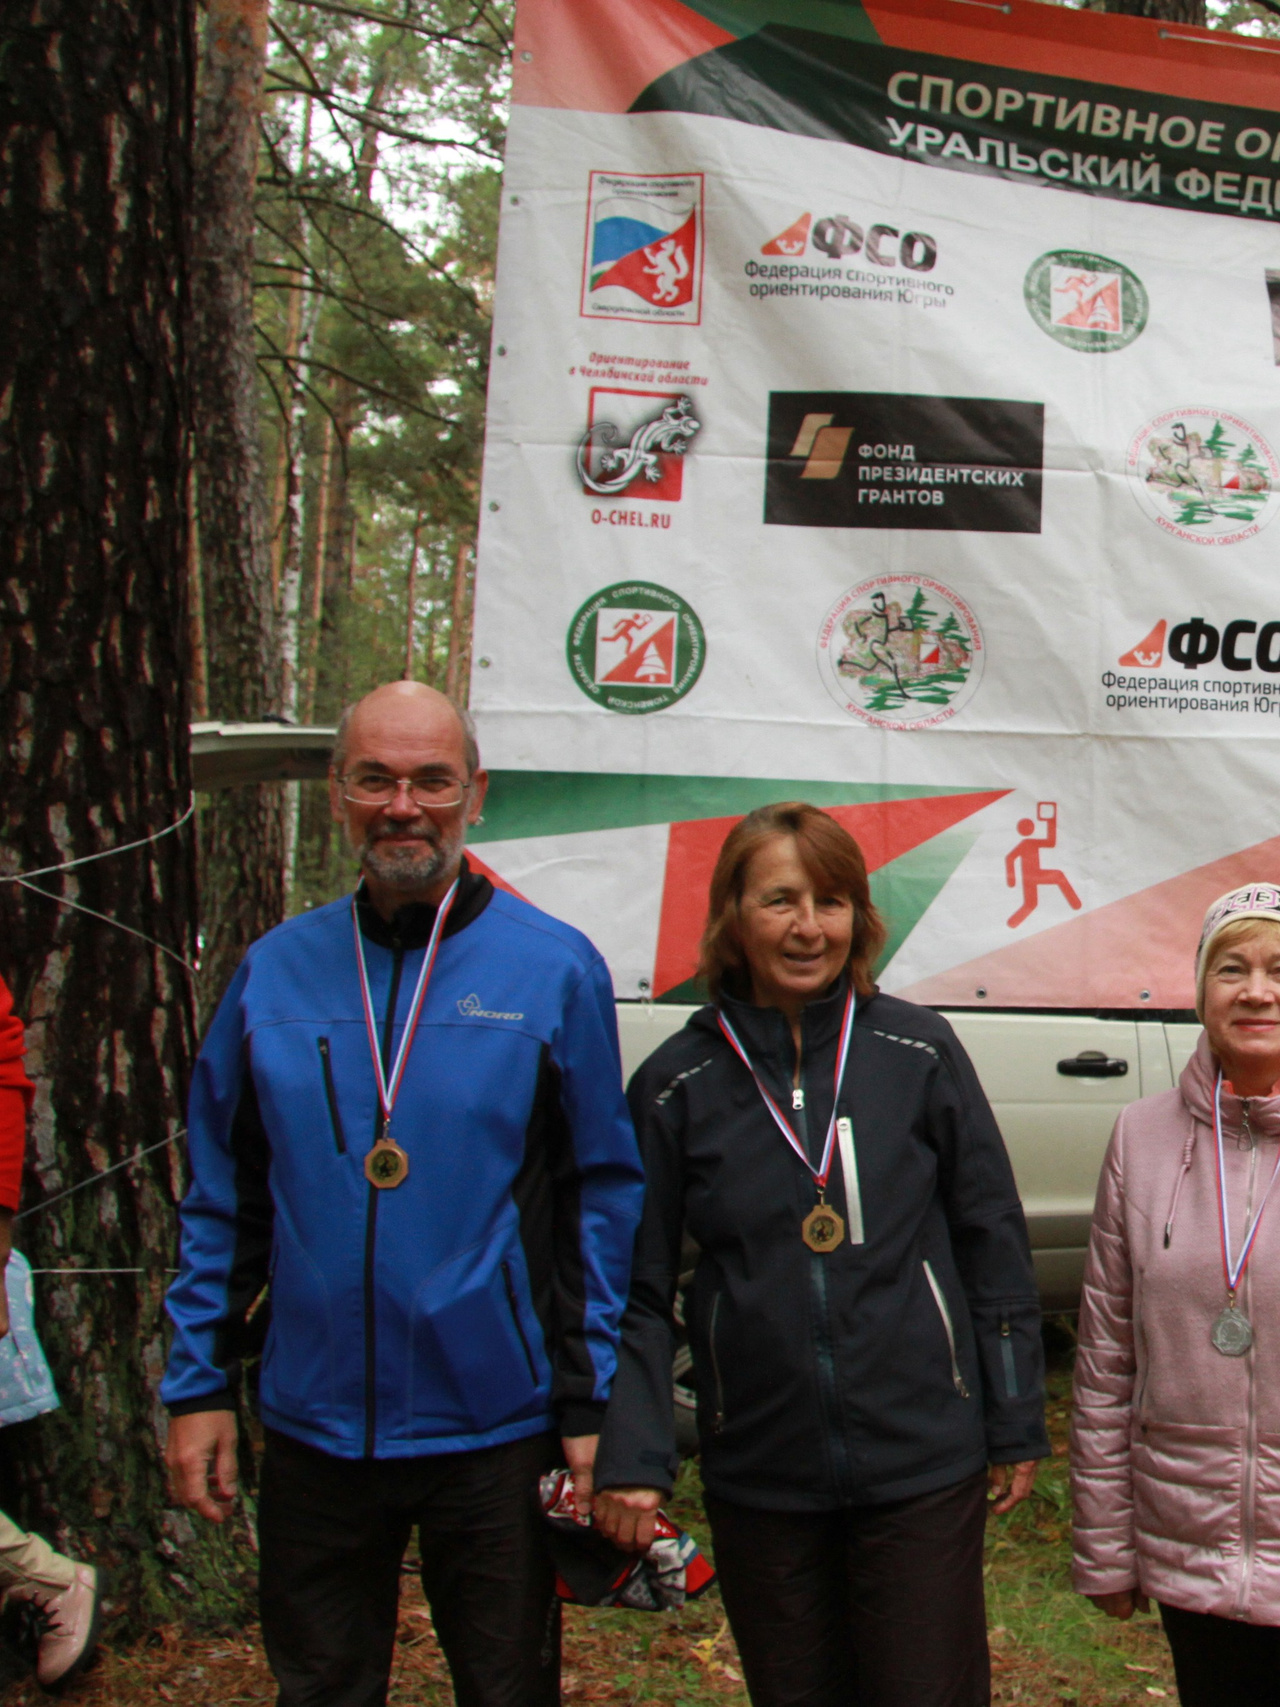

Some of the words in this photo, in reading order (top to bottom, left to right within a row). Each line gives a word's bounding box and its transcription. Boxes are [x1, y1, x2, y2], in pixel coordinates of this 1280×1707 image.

[887, 71, 1225, 154] СПОРТИВНОЕ
[886, 117, 1161, 194] УРАЛЬСКИЙ
[811, 213, 937, 272] ФСО
[744, 260, 842, 281] Федерация
[846, 268, 954, 296] спортивного
[750, 283, 892, 302] ориентирования
[858, 444, 916, 461] ФОНД
[858, 466, 1025, 487] ПРЕЗИДЕНТСКИХ
[858, 489, 944, 505] ГРАНТОВ
[591, 509, 671, 529] O-CHEL.RU
[1101, 670, 1199, 693] Федерация
[1106, 693, 1249, 713] ориентирования
